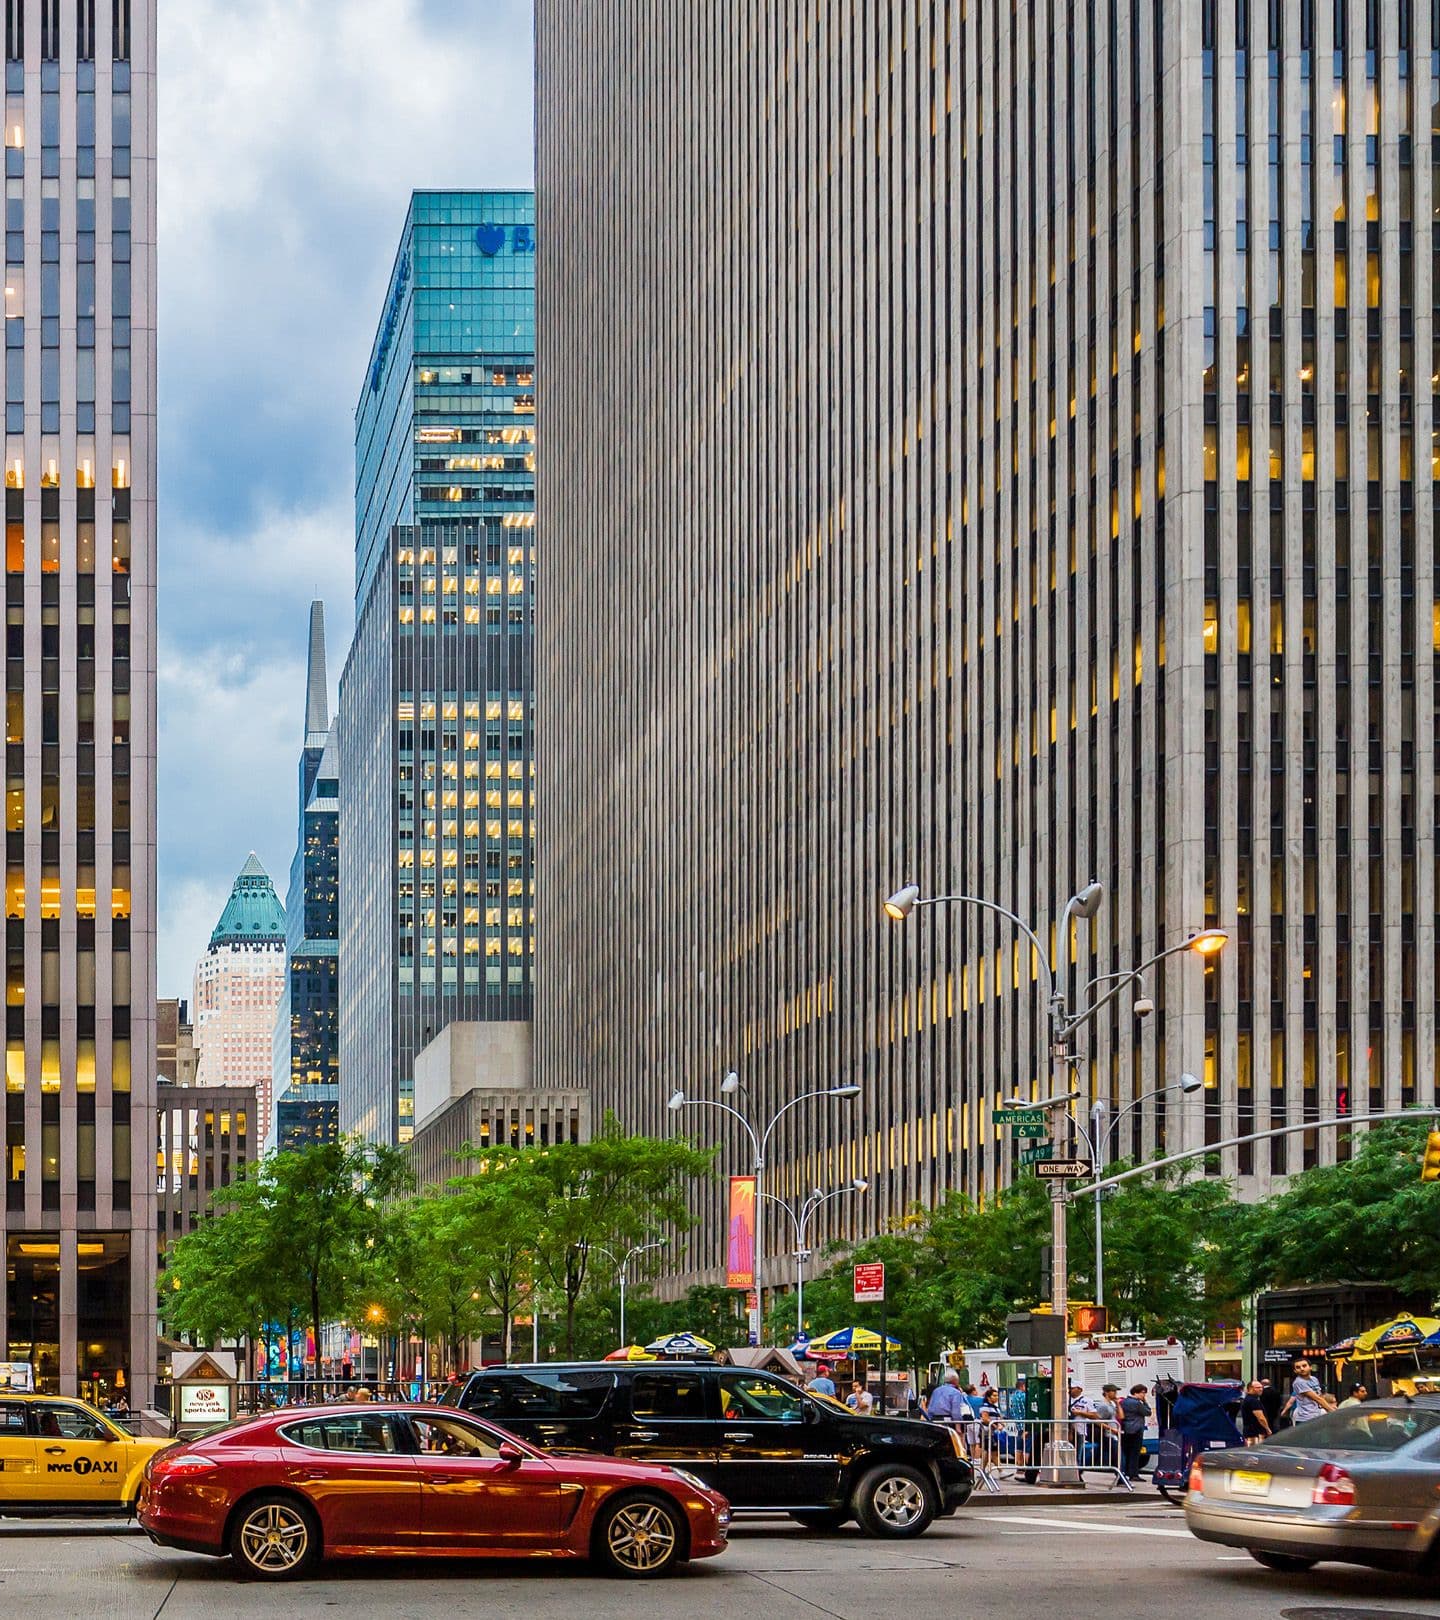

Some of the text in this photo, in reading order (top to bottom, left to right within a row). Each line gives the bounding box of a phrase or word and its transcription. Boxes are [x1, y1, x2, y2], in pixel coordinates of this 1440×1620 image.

[999, 1115, 1042, 1123] AMERICAS
[1019, 1126, 1026, 1137] 6
[1035, 1147, 1045, 1159] 49
[1042, 1165, 1084, 1173] ONE WAY
[1117, 1358, 1148, 1368] SLOW!
[47, 1463, 73, 1473] NYC
[73, 1456, 118, 1475] TAXI
